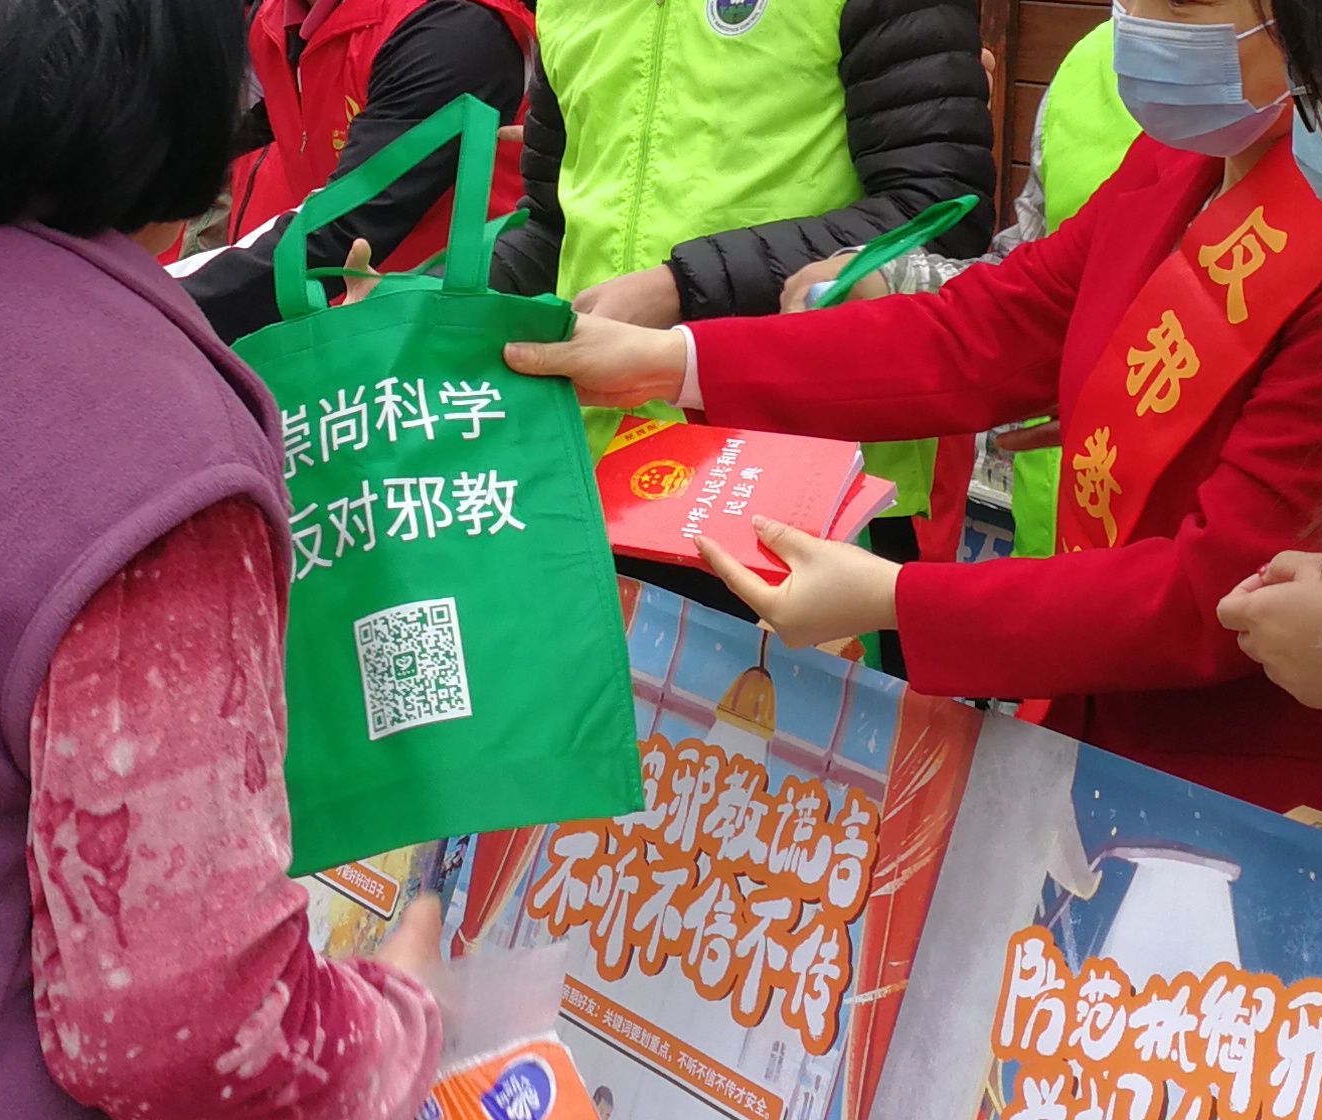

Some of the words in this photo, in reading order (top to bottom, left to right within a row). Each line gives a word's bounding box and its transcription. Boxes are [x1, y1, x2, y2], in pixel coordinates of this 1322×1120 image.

[281, 376, 506, 480] 崇尚科学
[1062, 205, 1289, 553] 反邪教
[288, 469, 526, 583] 反对邪教
[533, 831, 841, 1041] 不听不信不传
